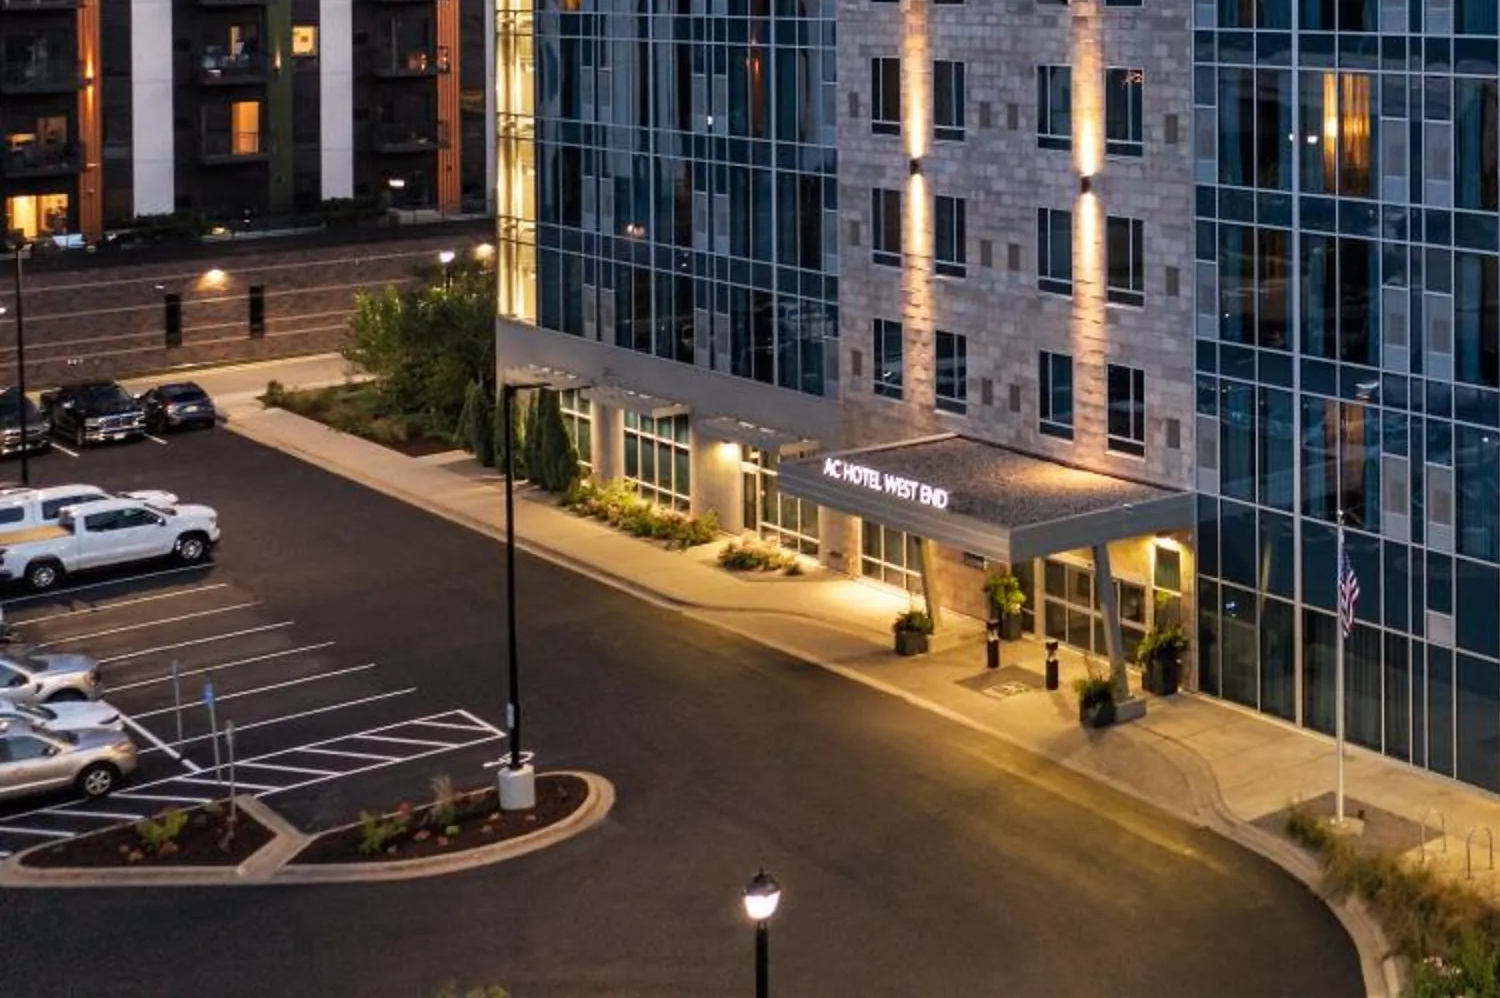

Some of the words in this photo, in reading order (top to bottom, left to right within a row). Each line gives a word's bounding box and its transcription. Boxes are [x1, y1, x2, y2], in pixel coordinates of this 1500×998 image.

[823, 457, 843, 479] AC
[843, 463, 882, 490] HOTEL
[884, 474, 919, 500] WEST
[919, 484, 949, 509] END
